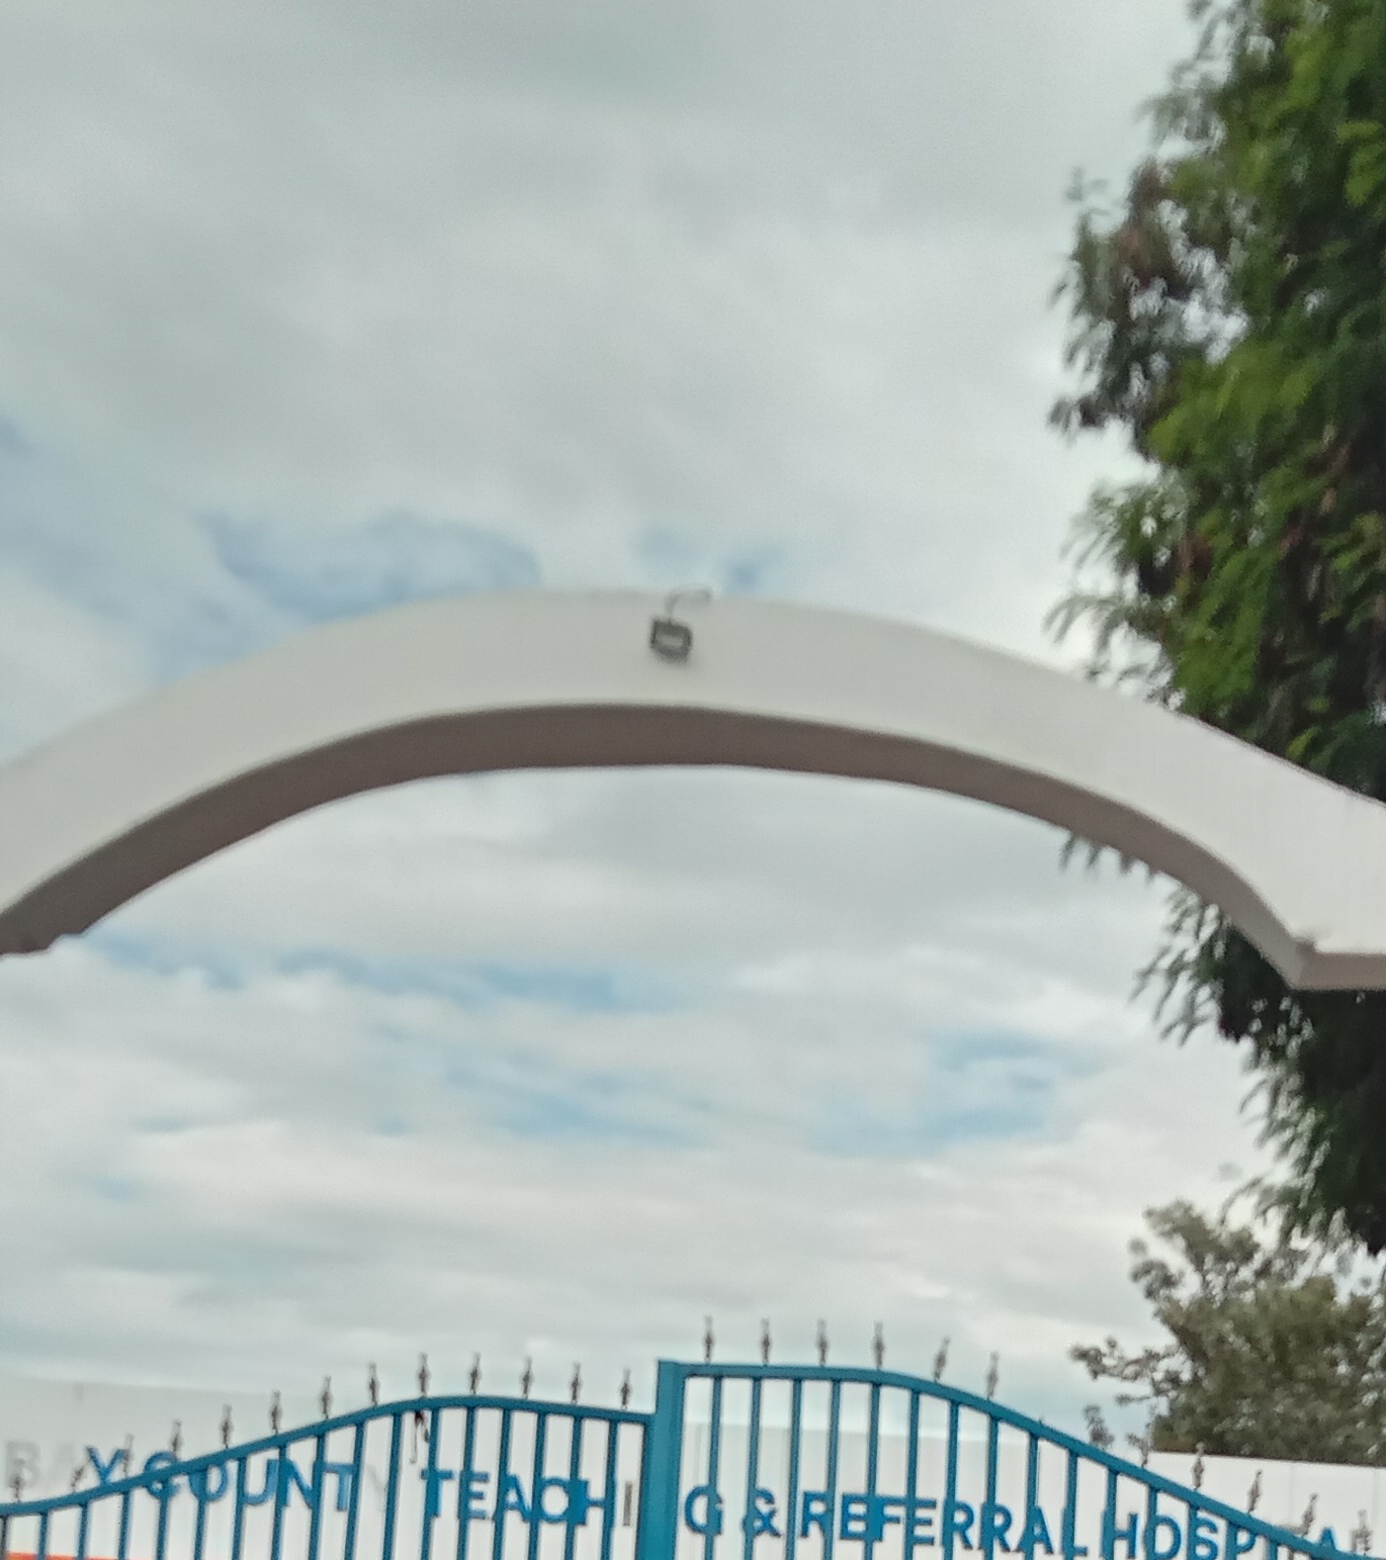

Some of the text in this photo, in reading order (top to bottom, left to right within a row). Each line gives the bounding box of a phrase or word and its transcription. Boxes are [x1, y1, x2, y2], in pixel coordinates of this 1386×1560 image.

[420, 1468, 722, 1535] TEACHIG
[743, 1487, 781, 1538] &
[800, 1490, 1088, 1557] REFERRAL
